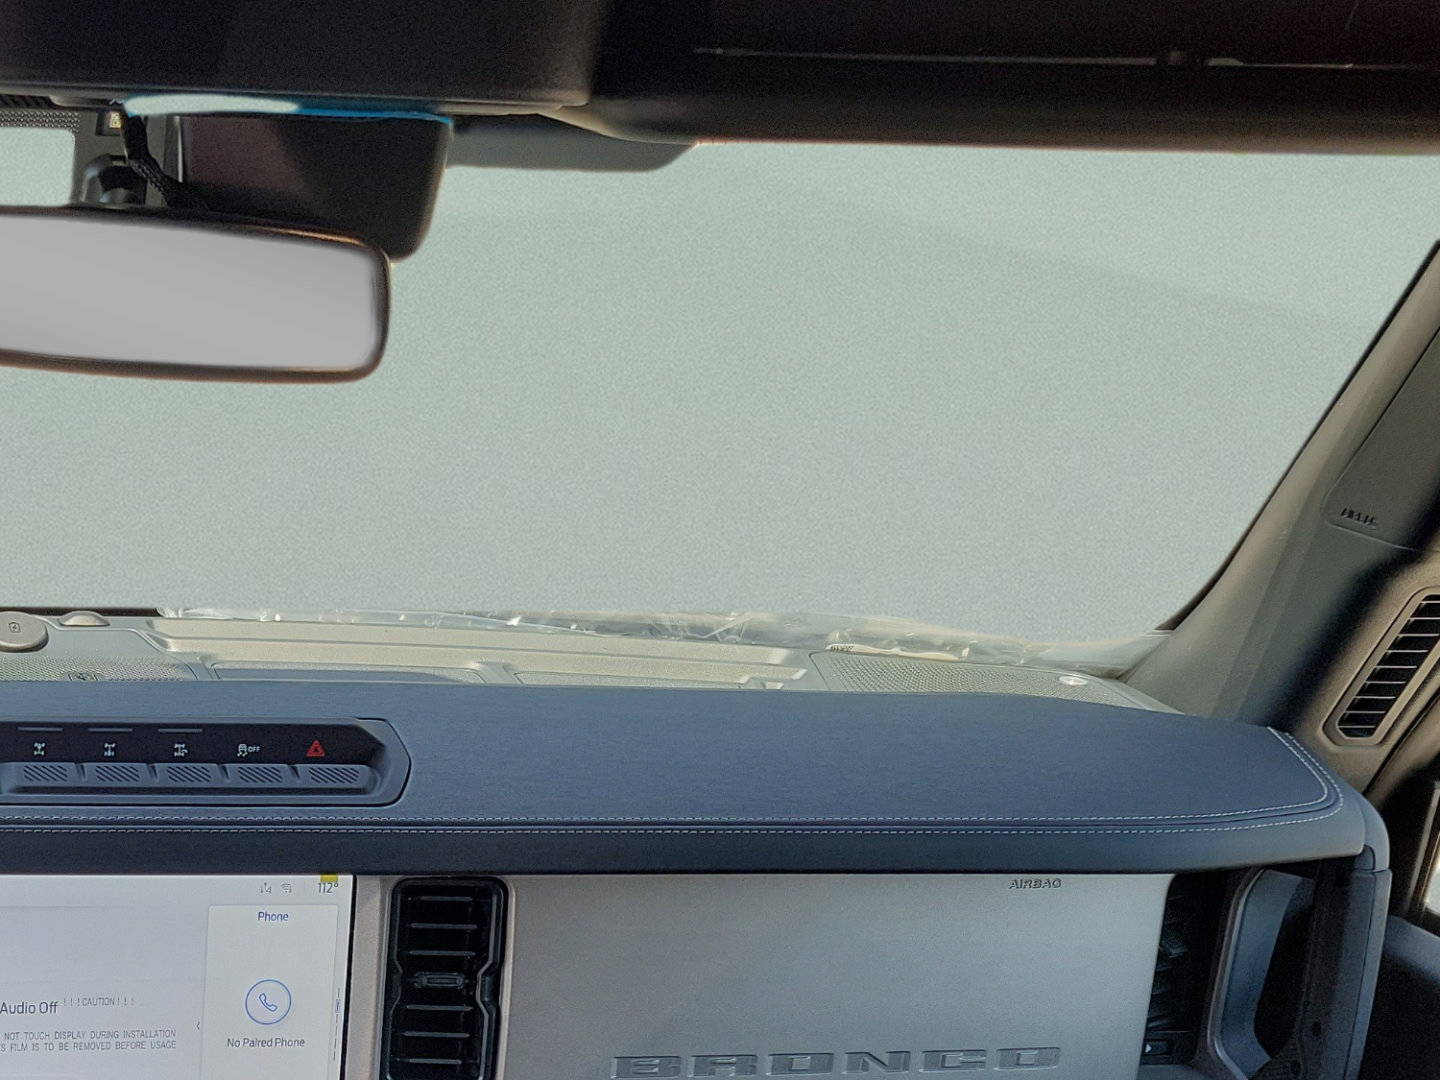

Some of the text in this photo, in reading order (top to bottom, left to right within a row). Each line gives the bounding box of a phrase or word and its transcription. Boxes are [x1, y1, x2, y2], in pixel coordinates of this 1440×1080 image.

[318, 882, 339, 894] 112°
[1009, 878, 1062, 889] AIRBAG
[257, 911, 289, 922] Phone
[82, 997, 115, 1006] CAUTION
[0, 1001, 58, 1015] Audio Off
[4, 1032, 20, 1040] NOT
[24, 1032, 50, 1040] TOUCH
[54, 1031, 86, 1040] DISPLAY
[90, 1030, 119, 1039] DURING
[123, 1029, 176, 1038] INSTALLATION
[10, 1043, 28, 1052] FILM
[32, 1043, 39, 1051] IS
[44, 1042, 54, 1051] TO
[58, 1042, 69, 1051] BE
[73, 1042, 111, 1050] REMOVED
[115, 1040, 146, 1050] BEFORE
[150, 1040, 176, 1049] USAGE
[227, 1038, 305, 1048] No Paired Phone
[610, 1046, 1060, 1080] BRONCO
